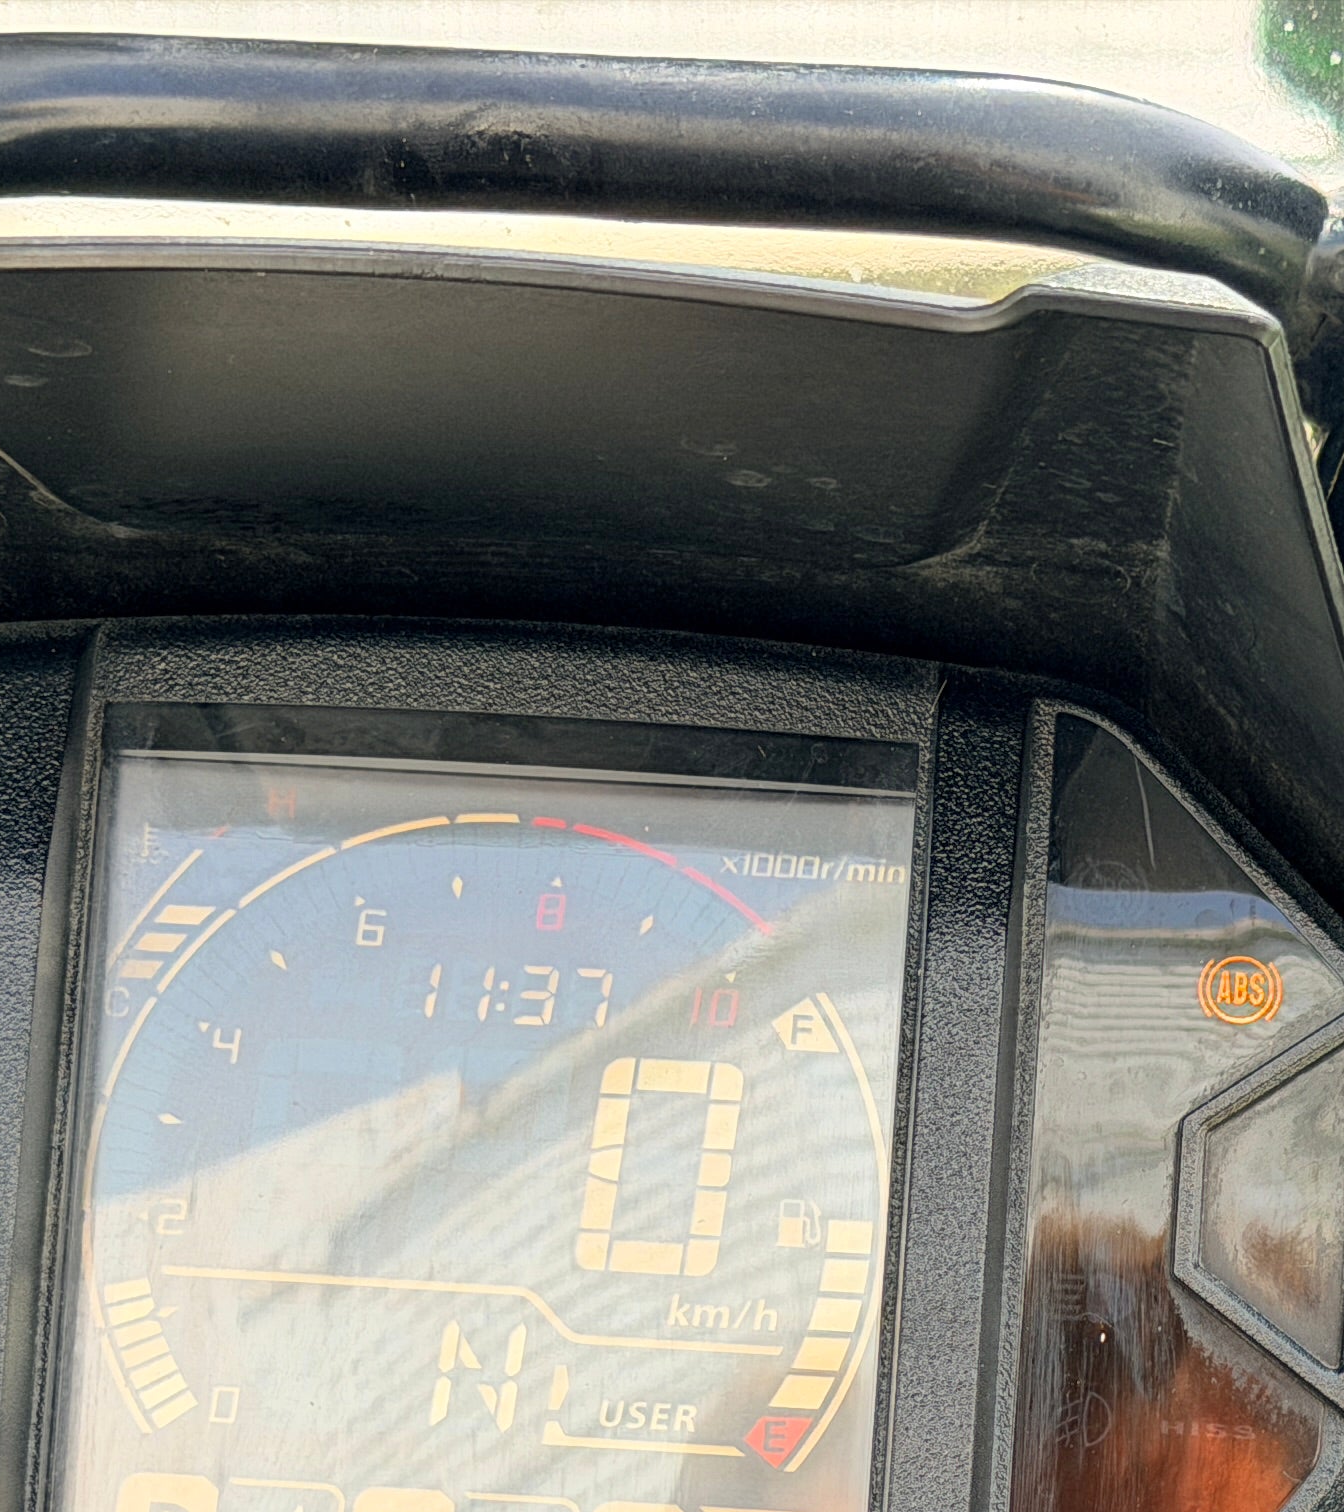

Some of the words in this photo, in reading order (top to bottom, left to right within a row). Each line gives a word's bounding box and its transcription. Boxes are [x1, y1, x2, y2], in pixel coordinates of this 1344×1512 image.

[267, 789, 296, 817] H
[356, 909, 386, 947] 6
[535, 893, 566, 931] 8
[106, 986, 130, 1018] C
[423, 963, 613, 1028] 11:37
[1216, 970, 1266, 1007] ABS
[690, 987, 741, 1028] 10
[212, 1028, 242, 1064] 4
[788, 1014, 815, 1045] F
[575, 1057, 744, 1277] 0
[157, 1201, 189, 1235] 2
[666, 1294, 779, 1332] km/h
[429, 1319, 528, 1433] N
[209, 1386, 240, 1424] 0
[600, 1399, 700, 1434] USER
[761, 1425, 789, 1454] E
